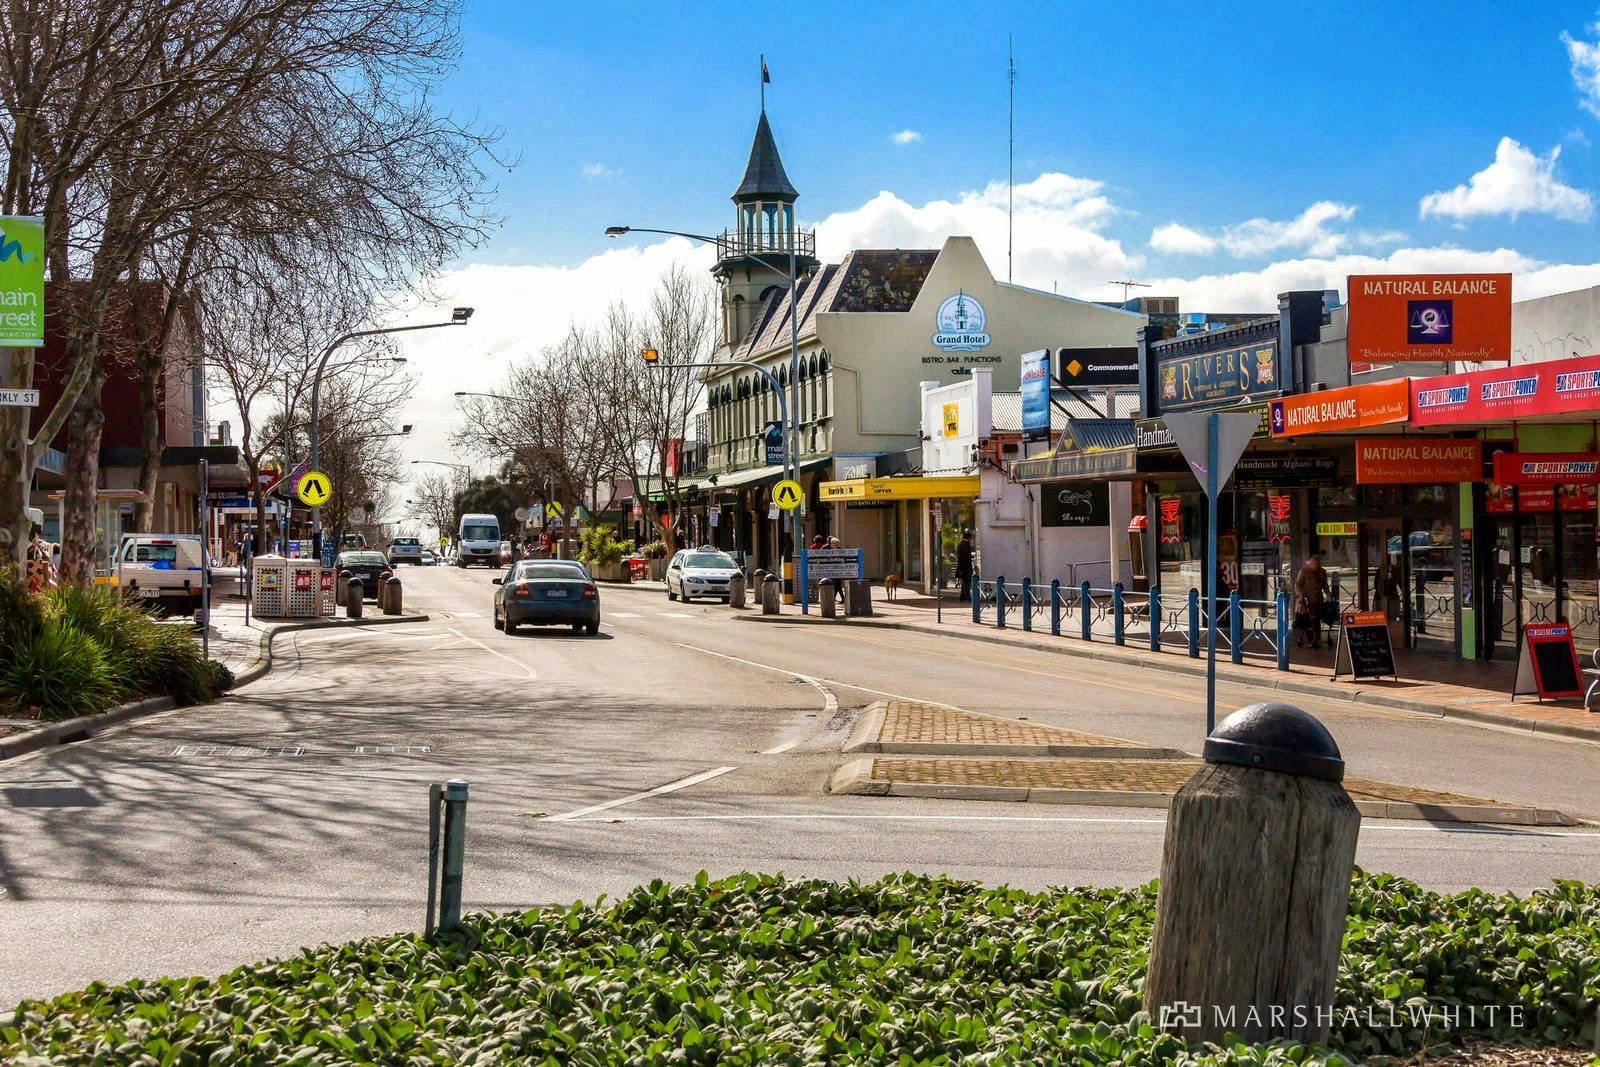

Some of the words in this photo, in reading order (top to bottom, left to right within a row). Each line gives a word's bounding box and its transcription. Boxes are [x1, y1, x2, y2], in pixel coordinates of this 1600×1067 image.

[1364, 281, 1429, 295] NATURAL
[1433, 280, 1497, 294] BALANCE
[936, 335, 961, 343] Grand
[963, 335, 986, 343] Hotel
[1181, 351, 1250, 400] RIVERS
[1491, 378, 1537, 399] SPORTSPOWER
[24, 394, 34, 402] ST
[1427, 386, 1468, 406] SPORTSPOWER
[1287, 405, 1320, 427] NATURAL
[1321, 400, 1356, 422] BALANCE
[1363, 447, 1420, 460] NATURAL
[1422, 446, 1476, 459] BALANCE
[1237, 459, 1278, 469] Handmade
[1316, 459, 1335, 469] Rugs
[1536, 463, 1596, 473] SPORTSPOWER
